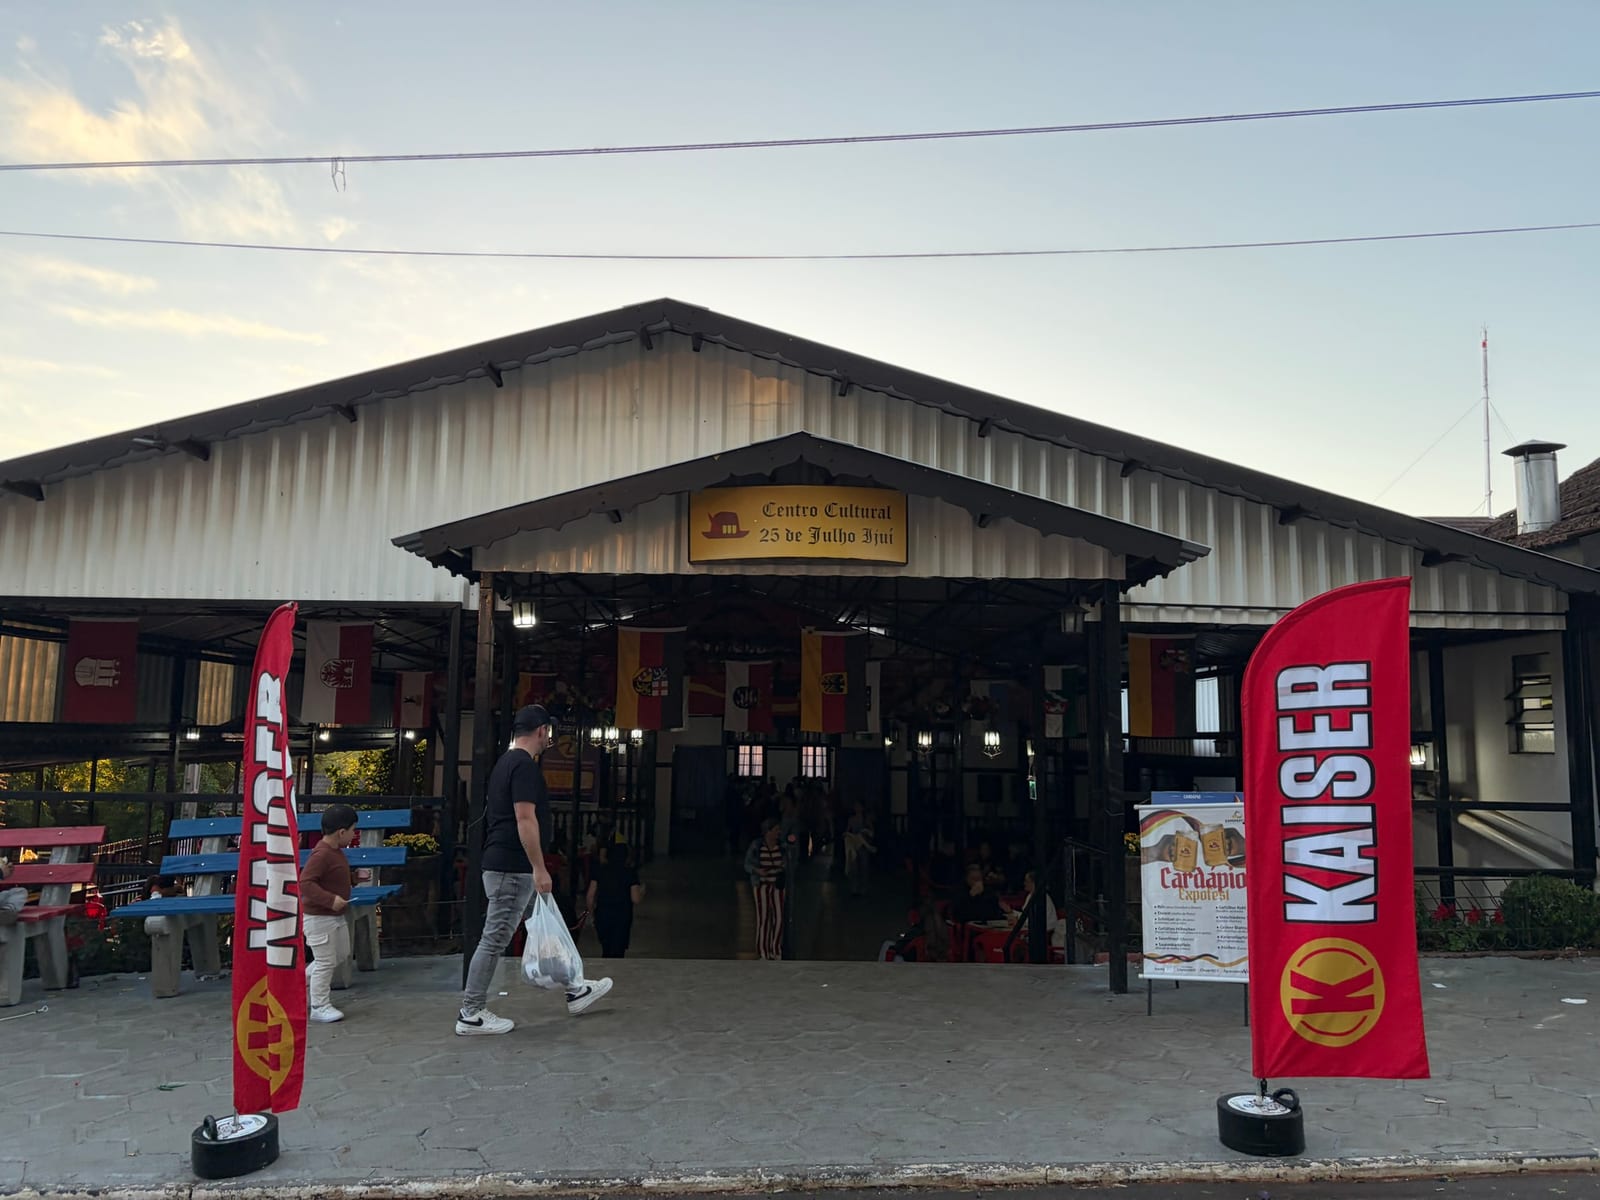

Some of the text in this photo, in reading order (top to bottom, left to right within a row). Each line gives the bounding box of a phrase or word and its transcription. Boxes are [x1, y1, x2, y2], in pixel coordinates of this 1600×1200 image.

[762, 502, 892, 520] Centro Cultural
[759, 526, 894, 546] 25 de Julho Ijuí
[1277, 661, 1377, 923] KAISER
[1160, 866, 1247, 891] Cardápio
